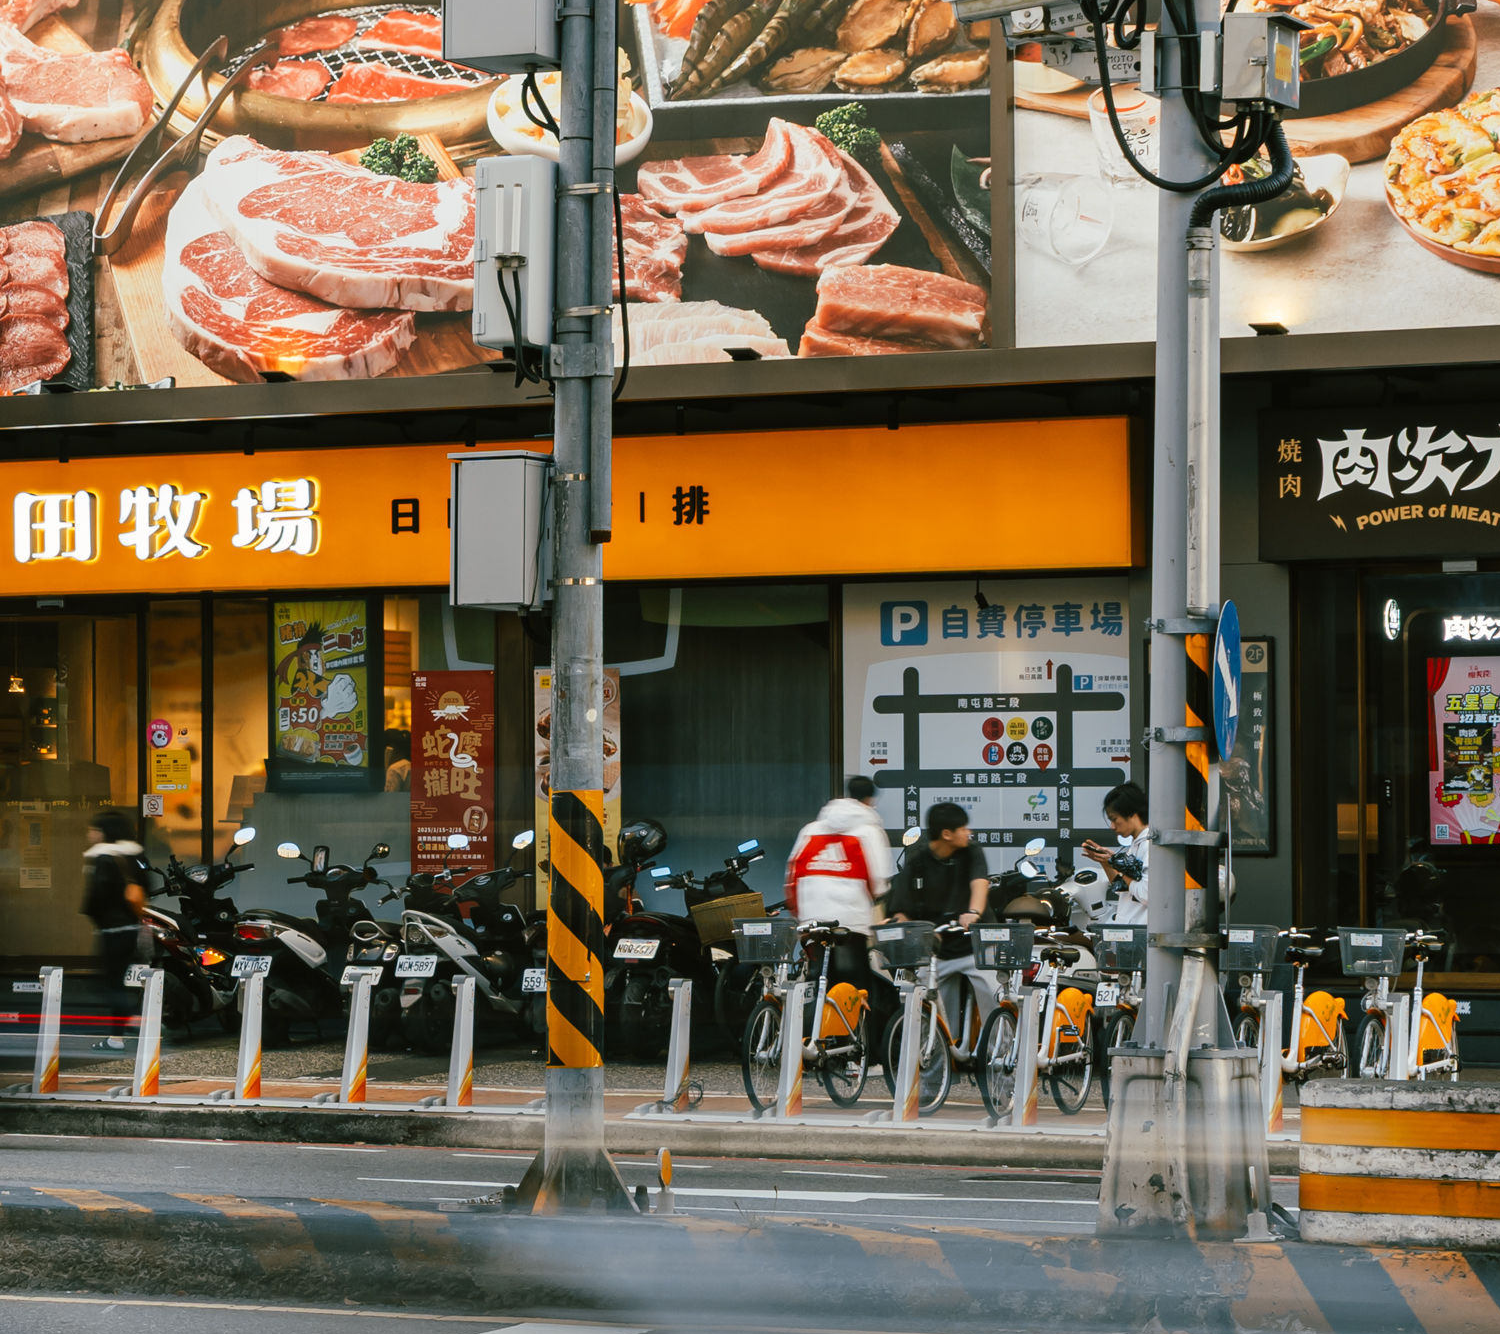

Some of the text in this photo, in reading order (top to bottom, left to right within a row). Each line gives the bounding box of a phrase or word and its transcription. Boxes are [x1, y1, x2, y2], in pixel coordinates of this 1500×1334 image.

[1093, 53, 1135, 65] KMOTO
[1111, 61, 1134, 71] CCTV
[1277, 437, 1303, 500] 燒肉
[1355, 503, 1424, 531] POWER
[1428, 503, 1448, 519] of
[891, 605, 921, 644] P
[940, 600, 1125, 641] 自費停車場
[1246, 647, 1263, 662] 2F
[1468, 684, 1492, 694] 2025
[957, 696, 1022, 710] 南屯路二段
[290, 706, 319, 724] $50
[952, 772, 1028, 785] 五權西路二段
[907, 785, 918, 828] 大墩路
[1059, 773, 1071, 840] 文心路一段
[1022, 811, 1050, 822] 南屯站
